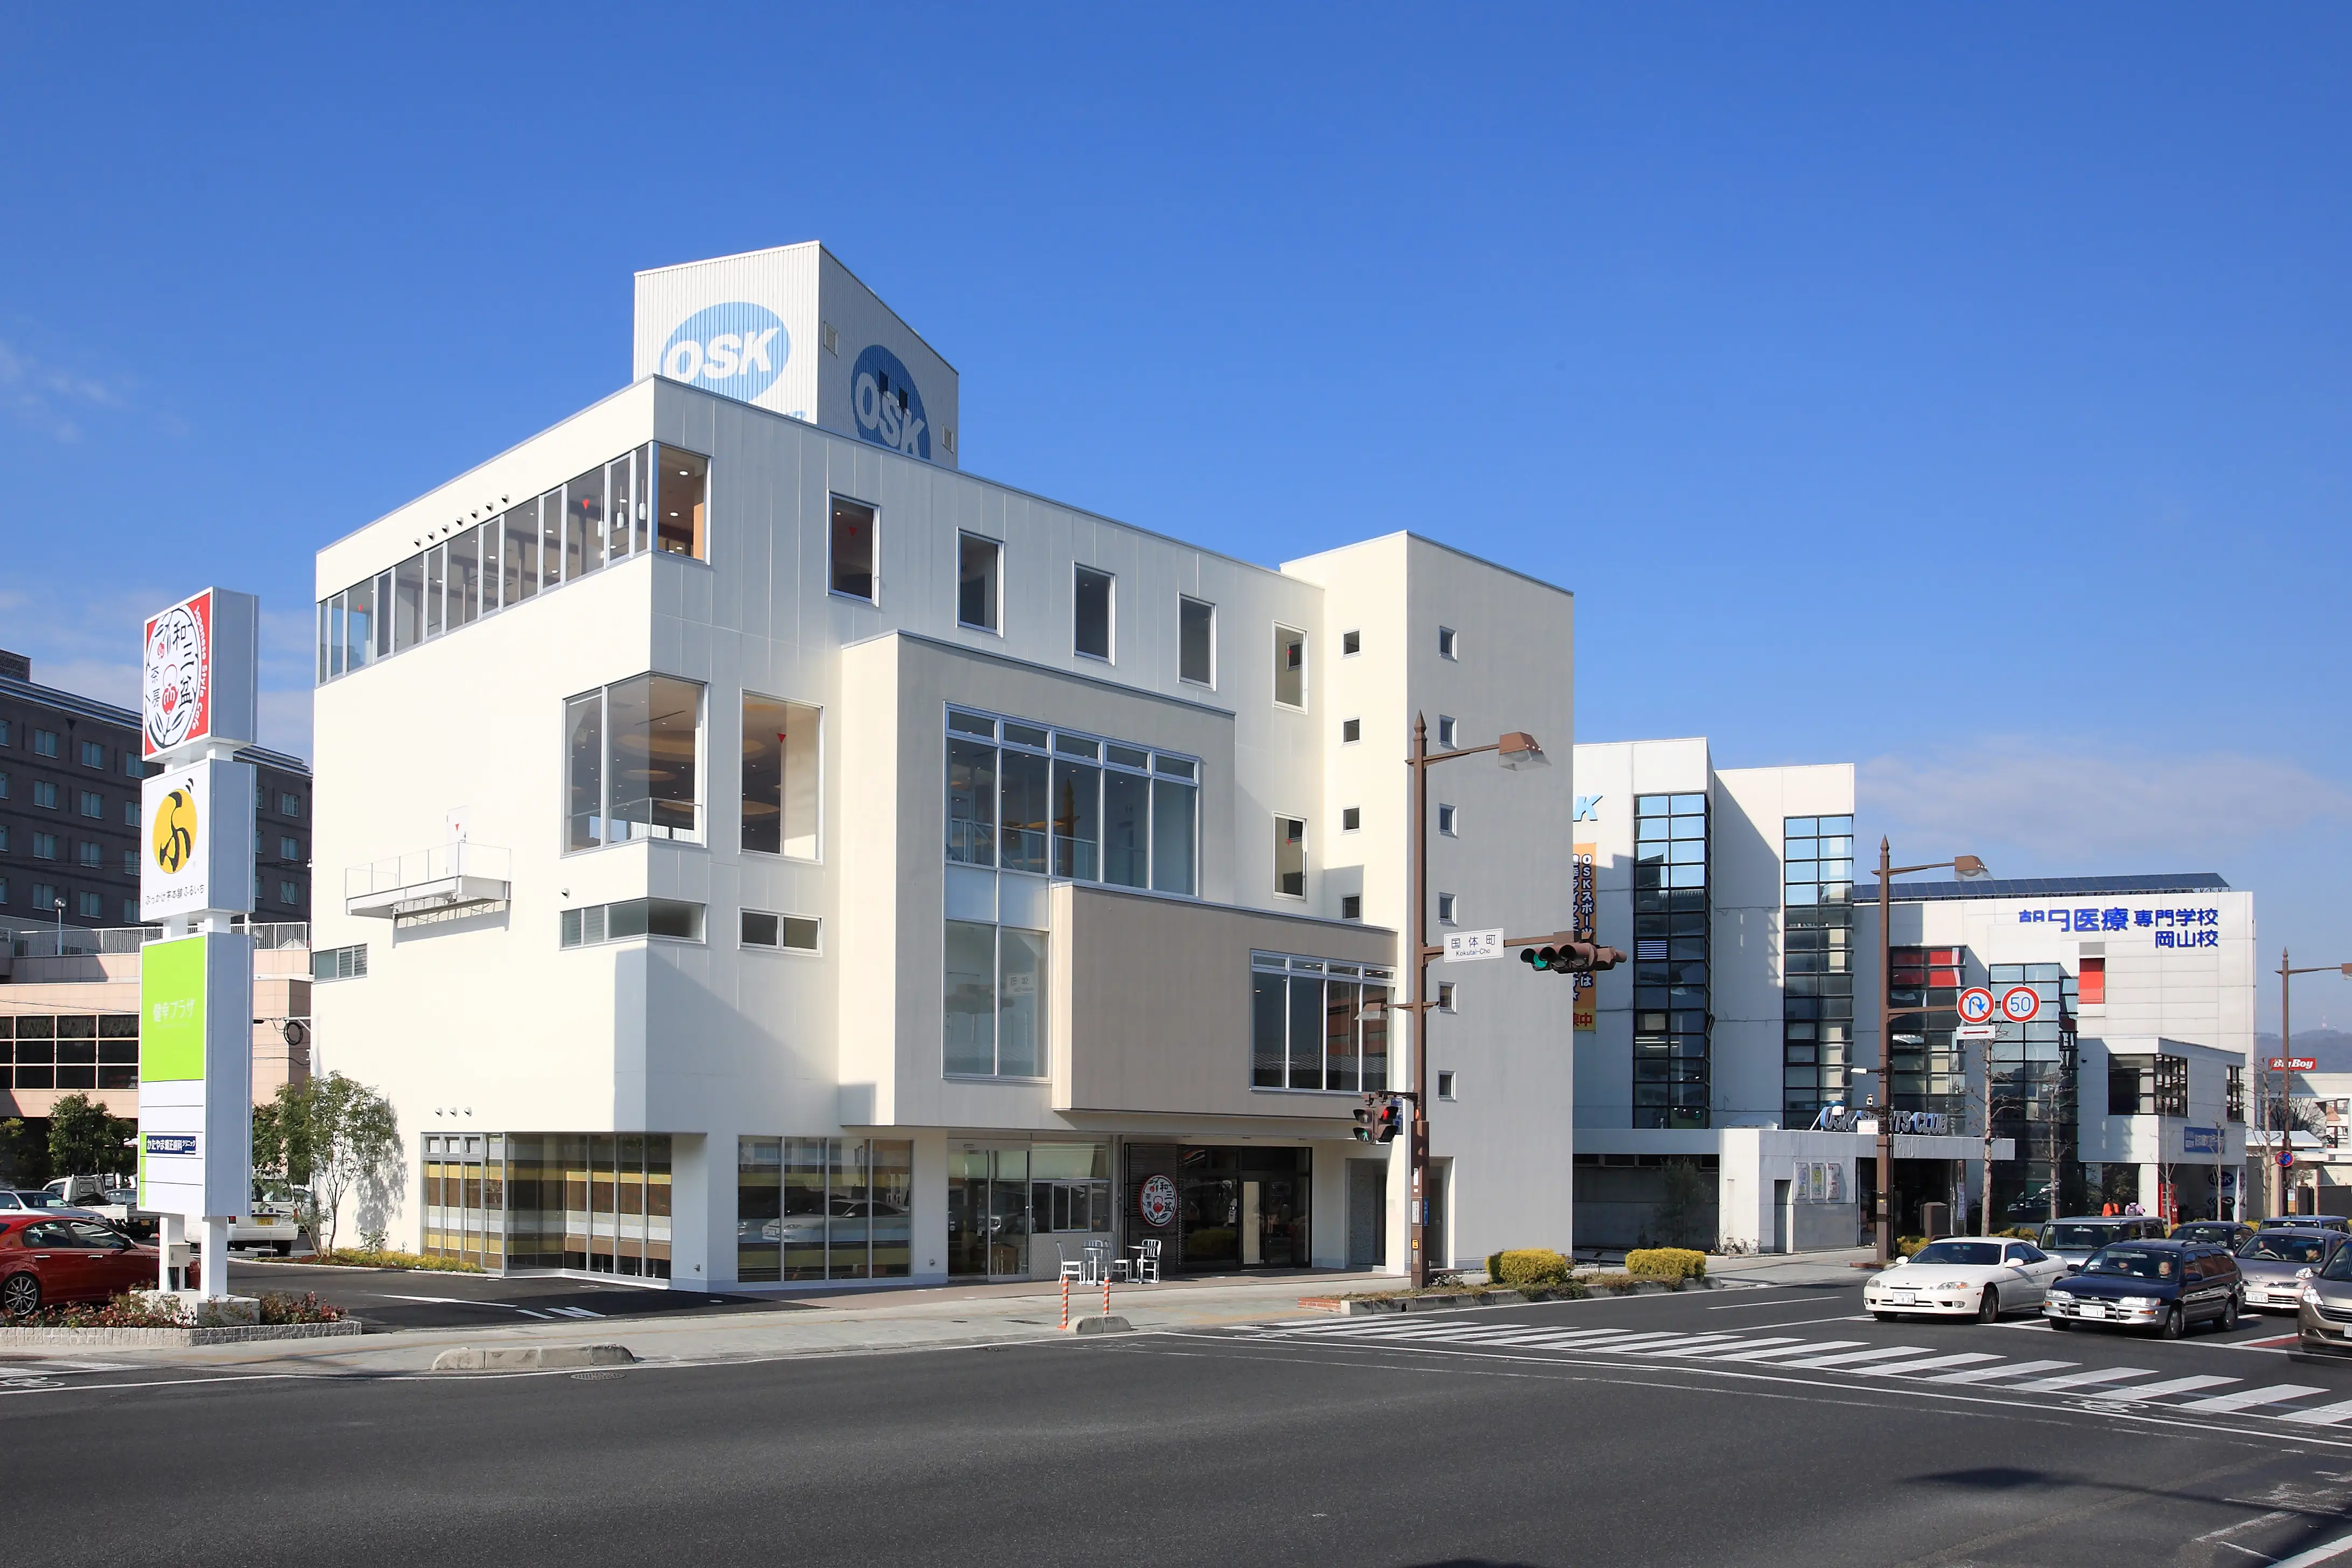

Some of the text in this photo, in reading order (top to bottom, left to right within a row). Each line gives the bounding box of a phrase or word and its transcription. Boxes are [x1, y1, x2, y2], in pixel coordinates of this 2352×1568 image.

[664, 327, 780, 383] OSK
[855, 372, 925, 457] OSK
[172, 620, 194, 709] 和三盆
[199, 664, 208, 698] Style
[192, 703, 203, 730] Cafe
[2155, 929, 2218, 949] 岡山校
[2010, 997, 2031, 1012] 50
[1912, 1111, 1948, 1134] CLUB
